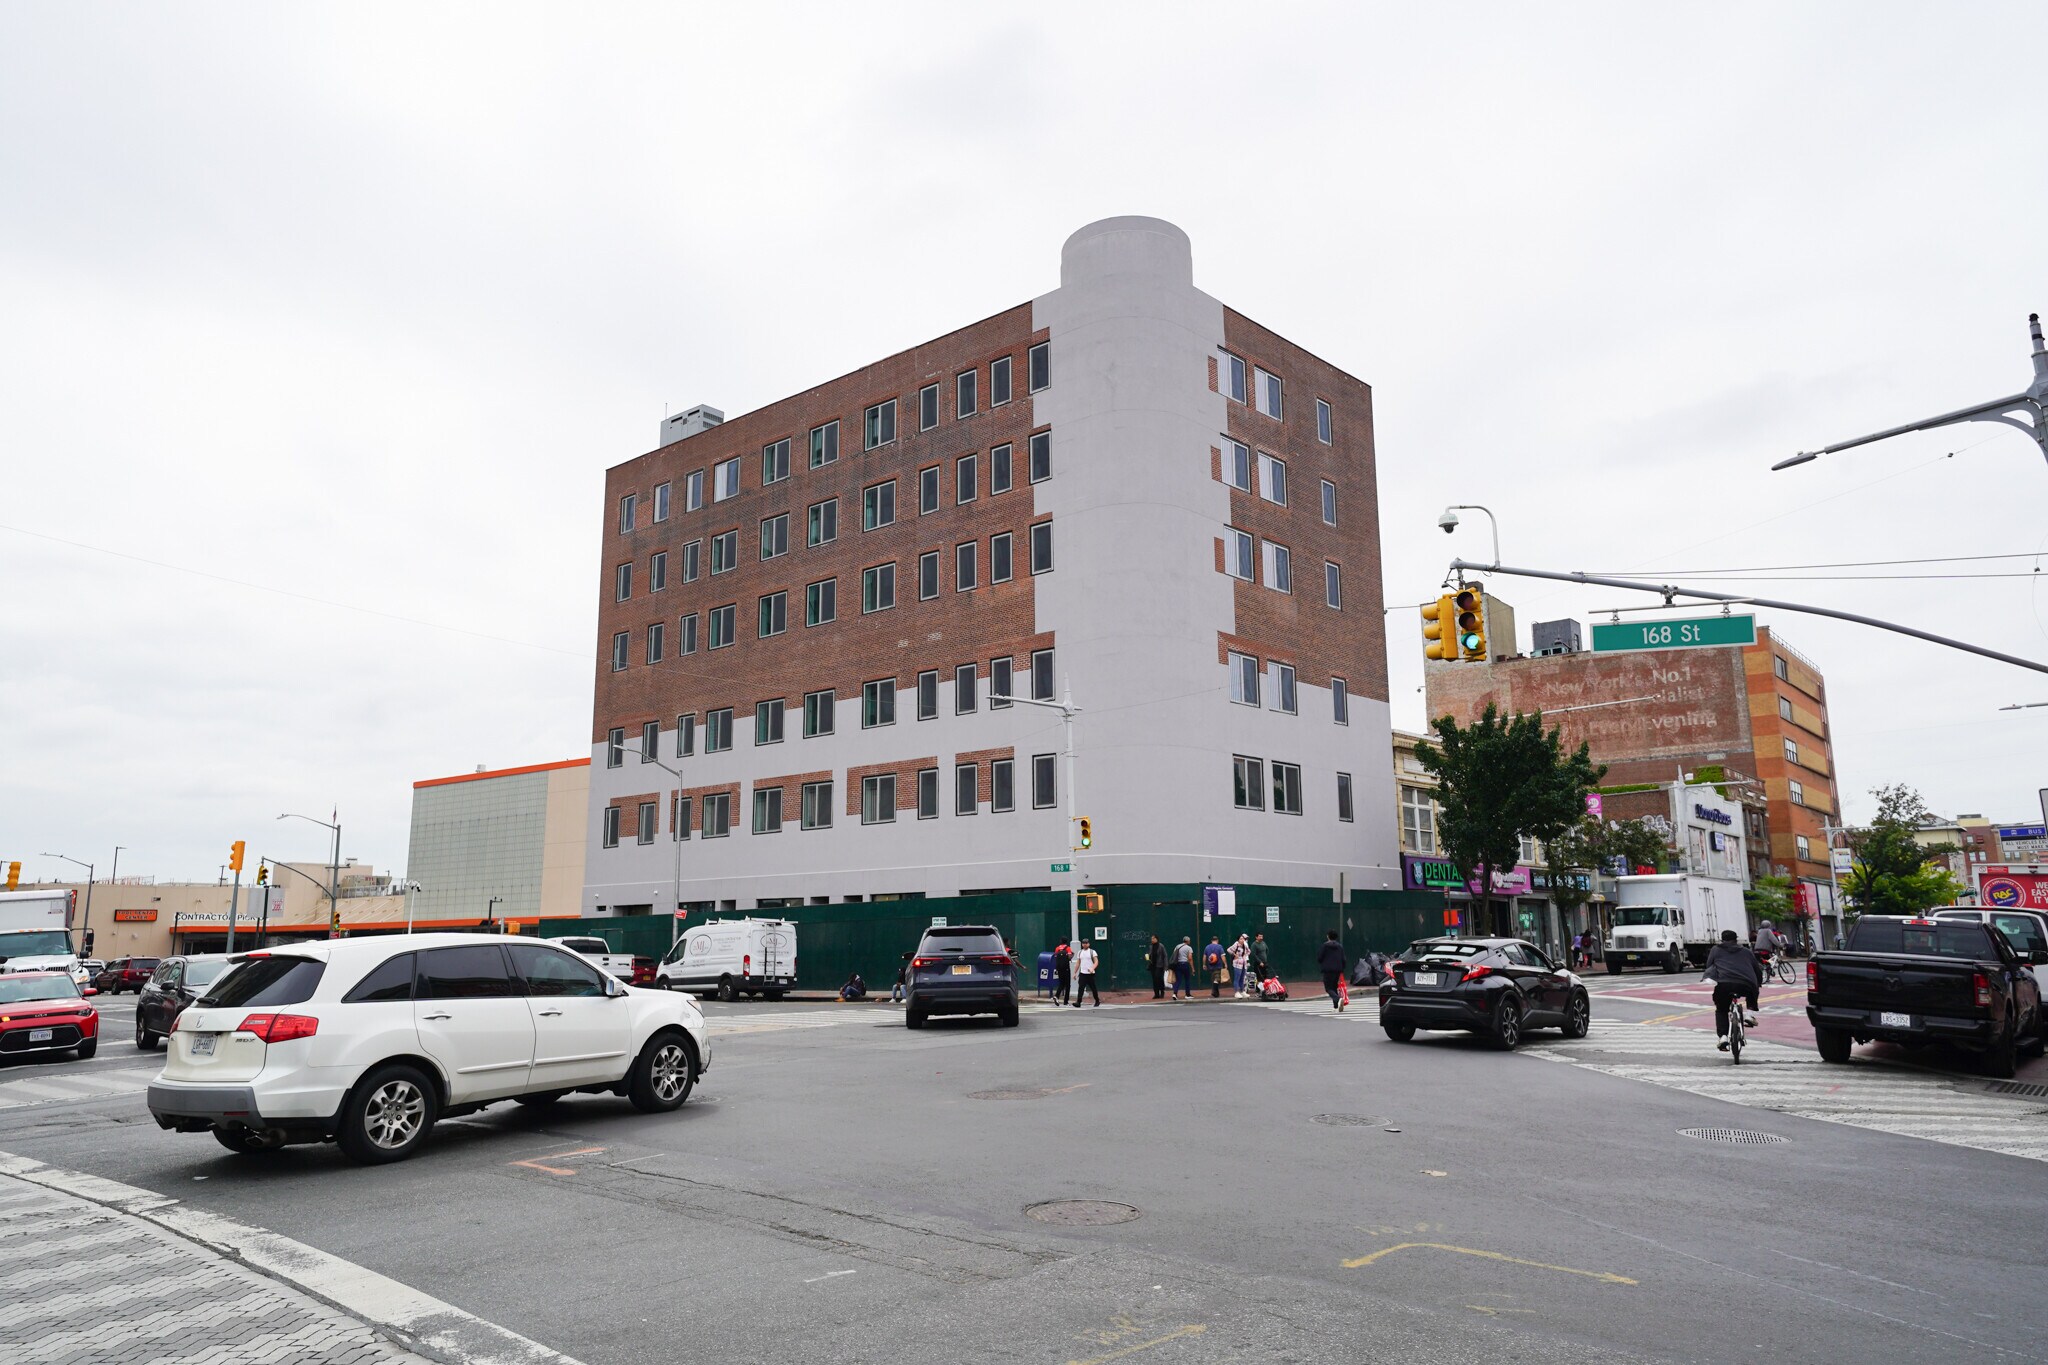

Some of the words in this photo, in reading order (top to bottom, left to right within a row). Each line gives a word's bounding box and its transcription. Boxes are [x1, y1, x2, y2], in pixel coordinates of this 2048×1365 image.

[1642, 626, 1671, 644] 168
[1681, 624, 1700, 642] St
[1652, 667, 1691, 684] No.1
[1993, 888, 2013, 899] RAC
